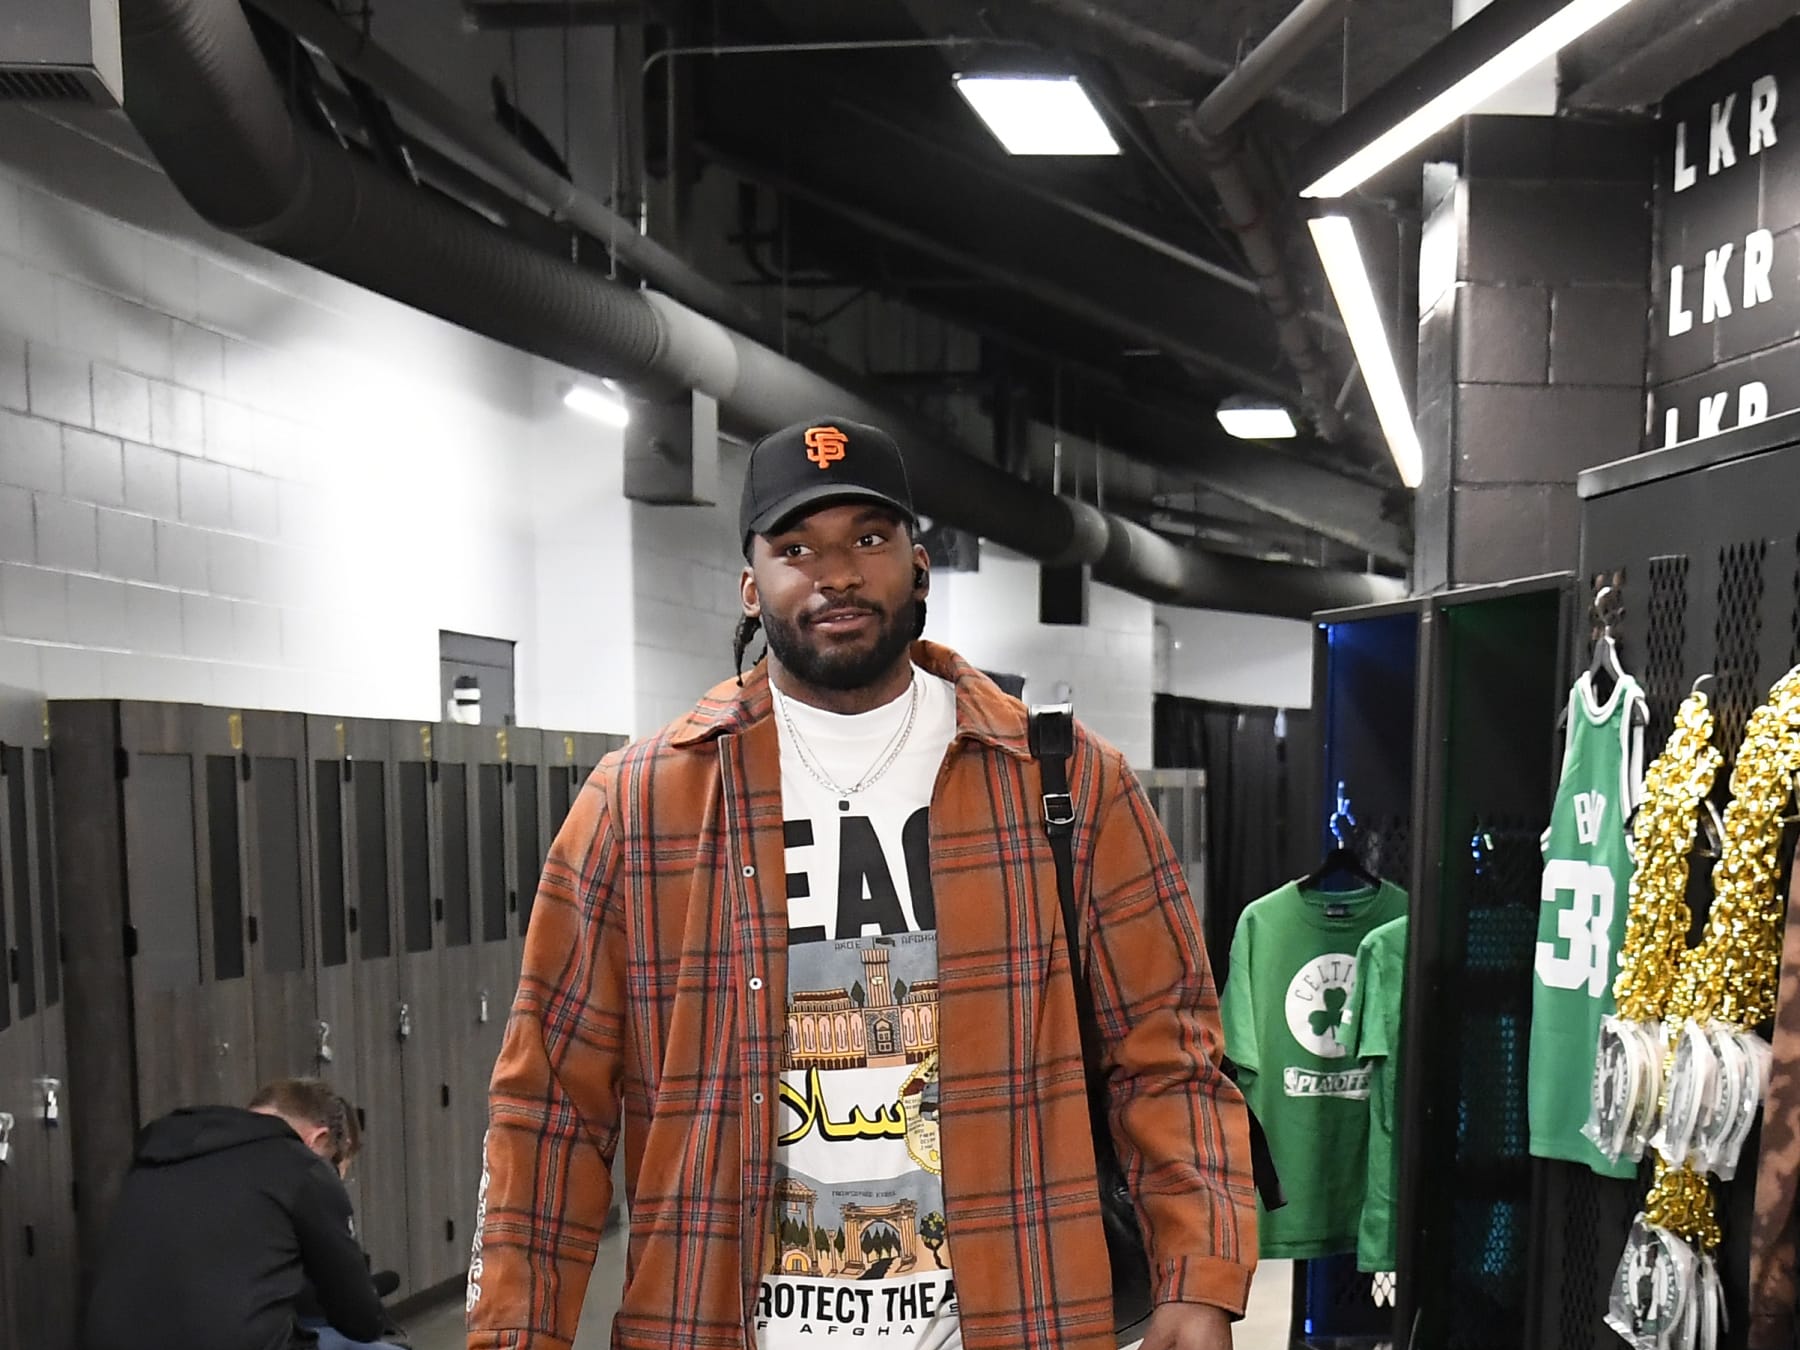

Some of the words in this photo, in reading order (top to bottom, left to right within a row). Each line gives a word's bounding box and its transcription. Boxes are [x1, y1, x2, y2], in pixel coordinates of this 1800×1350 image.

[1674, 75, 1778, 192] LKR
[1668, 228, 1774, 337] LKR
[804, 426, 849, 469] SF
[1294, 960, 1355, 1002] CELTI
[1297, 1074, 1369, 1093] PLAYOFF
[882, 1282, 936, 1322] THE
